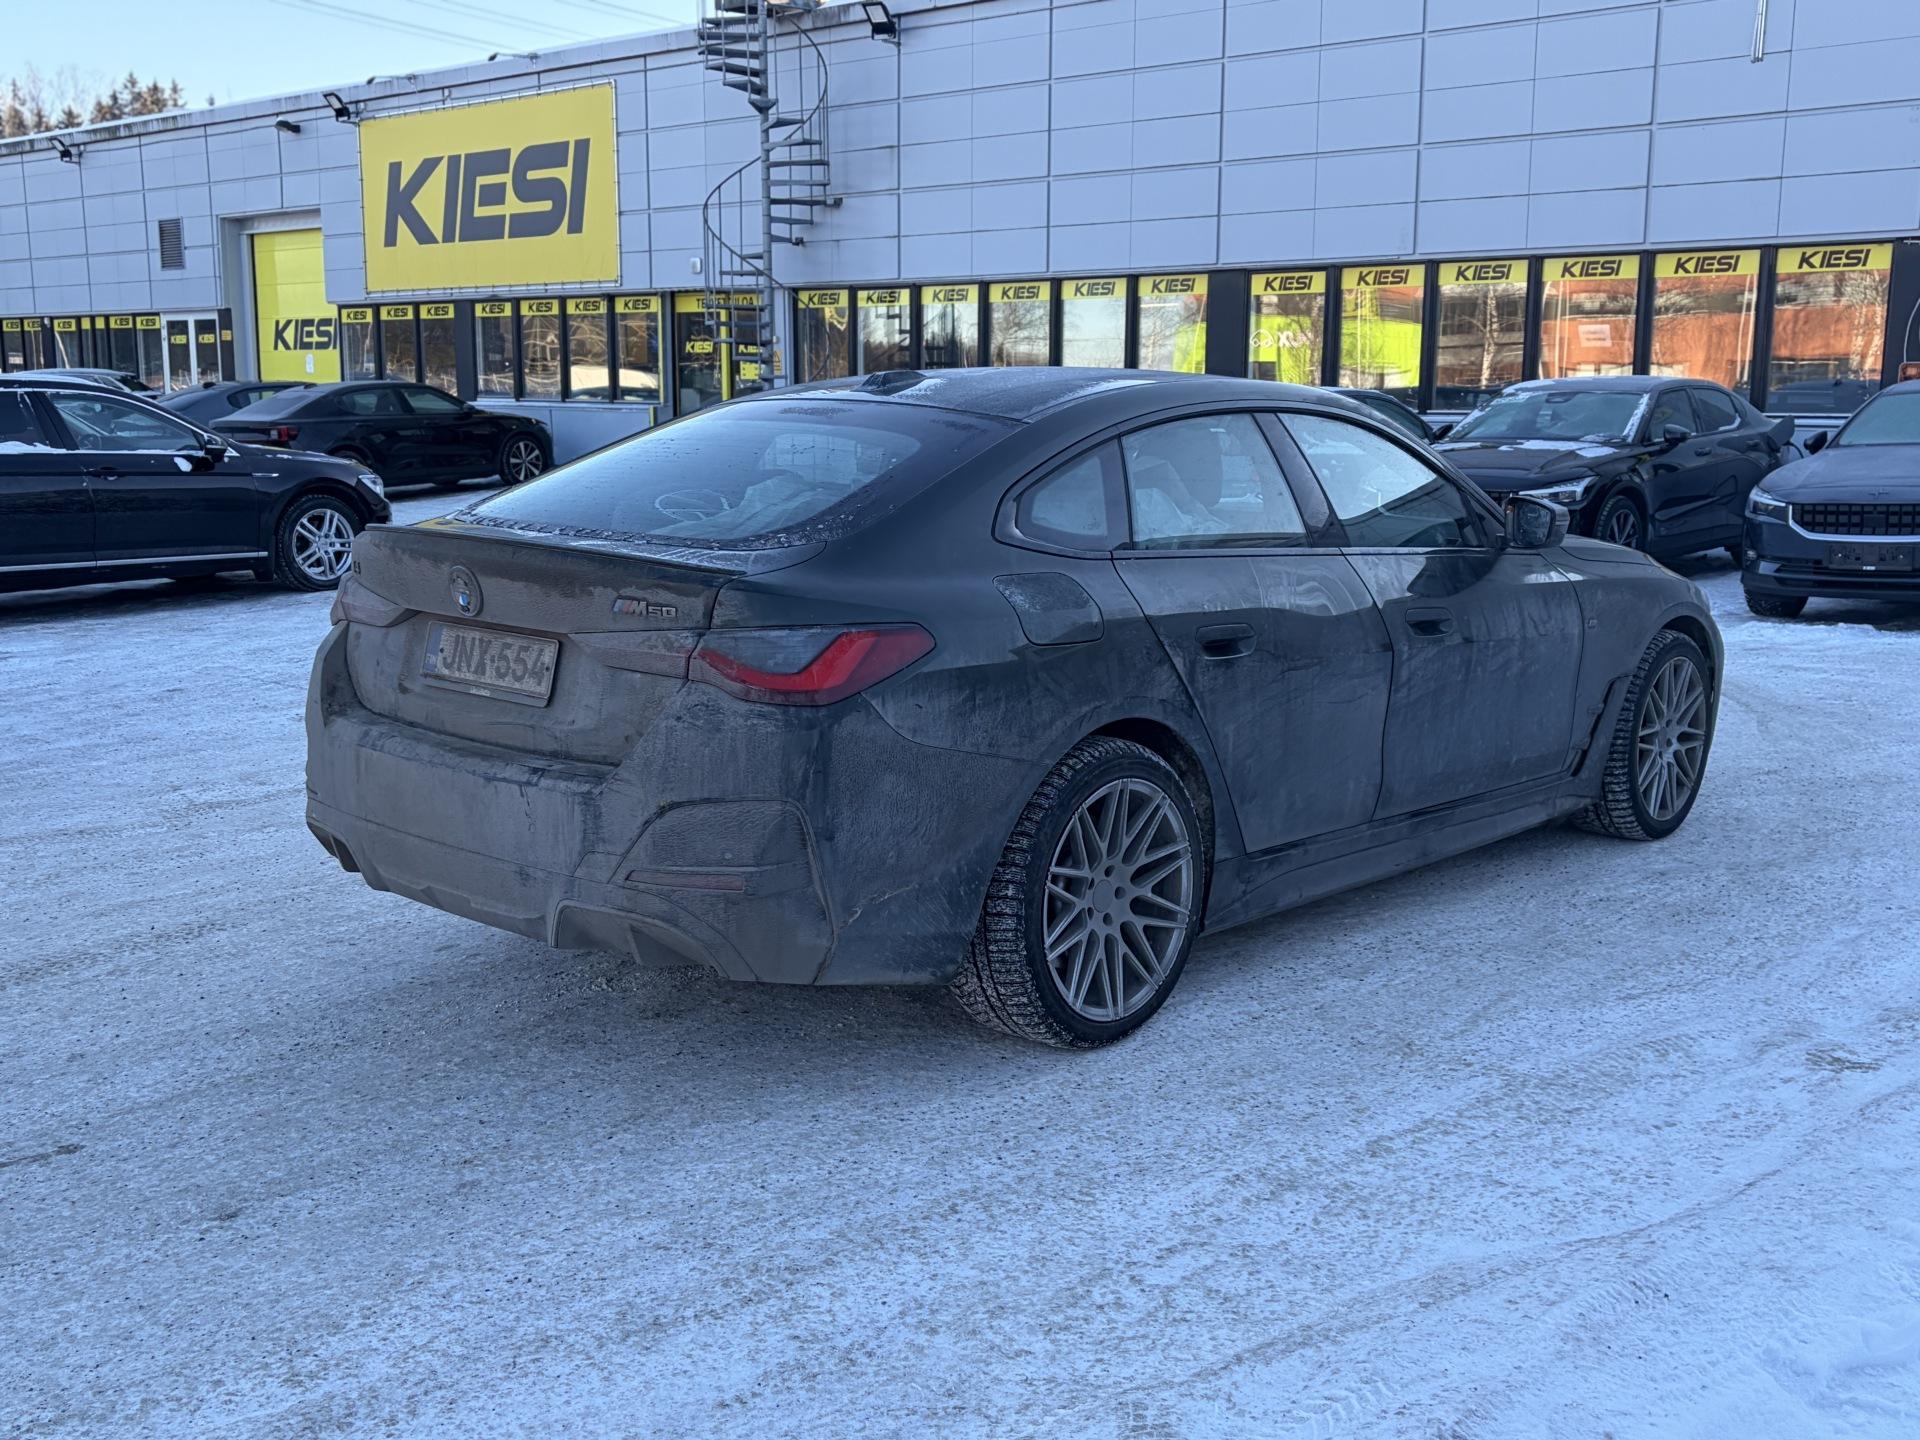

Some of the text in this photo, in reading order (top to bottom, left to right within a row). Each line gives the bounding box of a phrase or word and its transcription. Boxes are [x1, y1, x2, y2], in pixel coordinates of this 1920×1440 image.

[384, 138, 591, 248] KIESI
[1674, 255, 1741, 274] KIESI
[1798, 249, 1872, 270] KIESI
[1455, 264, 1512, 282] KIESI
[1561, 259, 1622, 278] KIESI
[1264, 275, 1313, 291] KIESI
[1356, 269, 1409, 287] KIESI
[1001, 285, 1041, 300] KIESI
[1074, 282, 1116, 297] KIESI
[1151, 278, 1196, 294] KIESI
[807, 292, 840, 306] KIESI
[866, 290, 902, 304] KIESI
[932, 288, 969, 302] KIESI
[426, 306, 450, 317] KIESI
[481, 303, 505, 314] KIESI
[528, 302, 553, 313] KIESI
[574, 300, 601, 312] KIESI
[623, 299, 651, 310] KIESI
[346, 310, 367, 321] KIESI
[387, 307, 408, 318] KIESI
[273, 318, 337, 351] KIESI
[685, 341, 713, 353] KIESI
